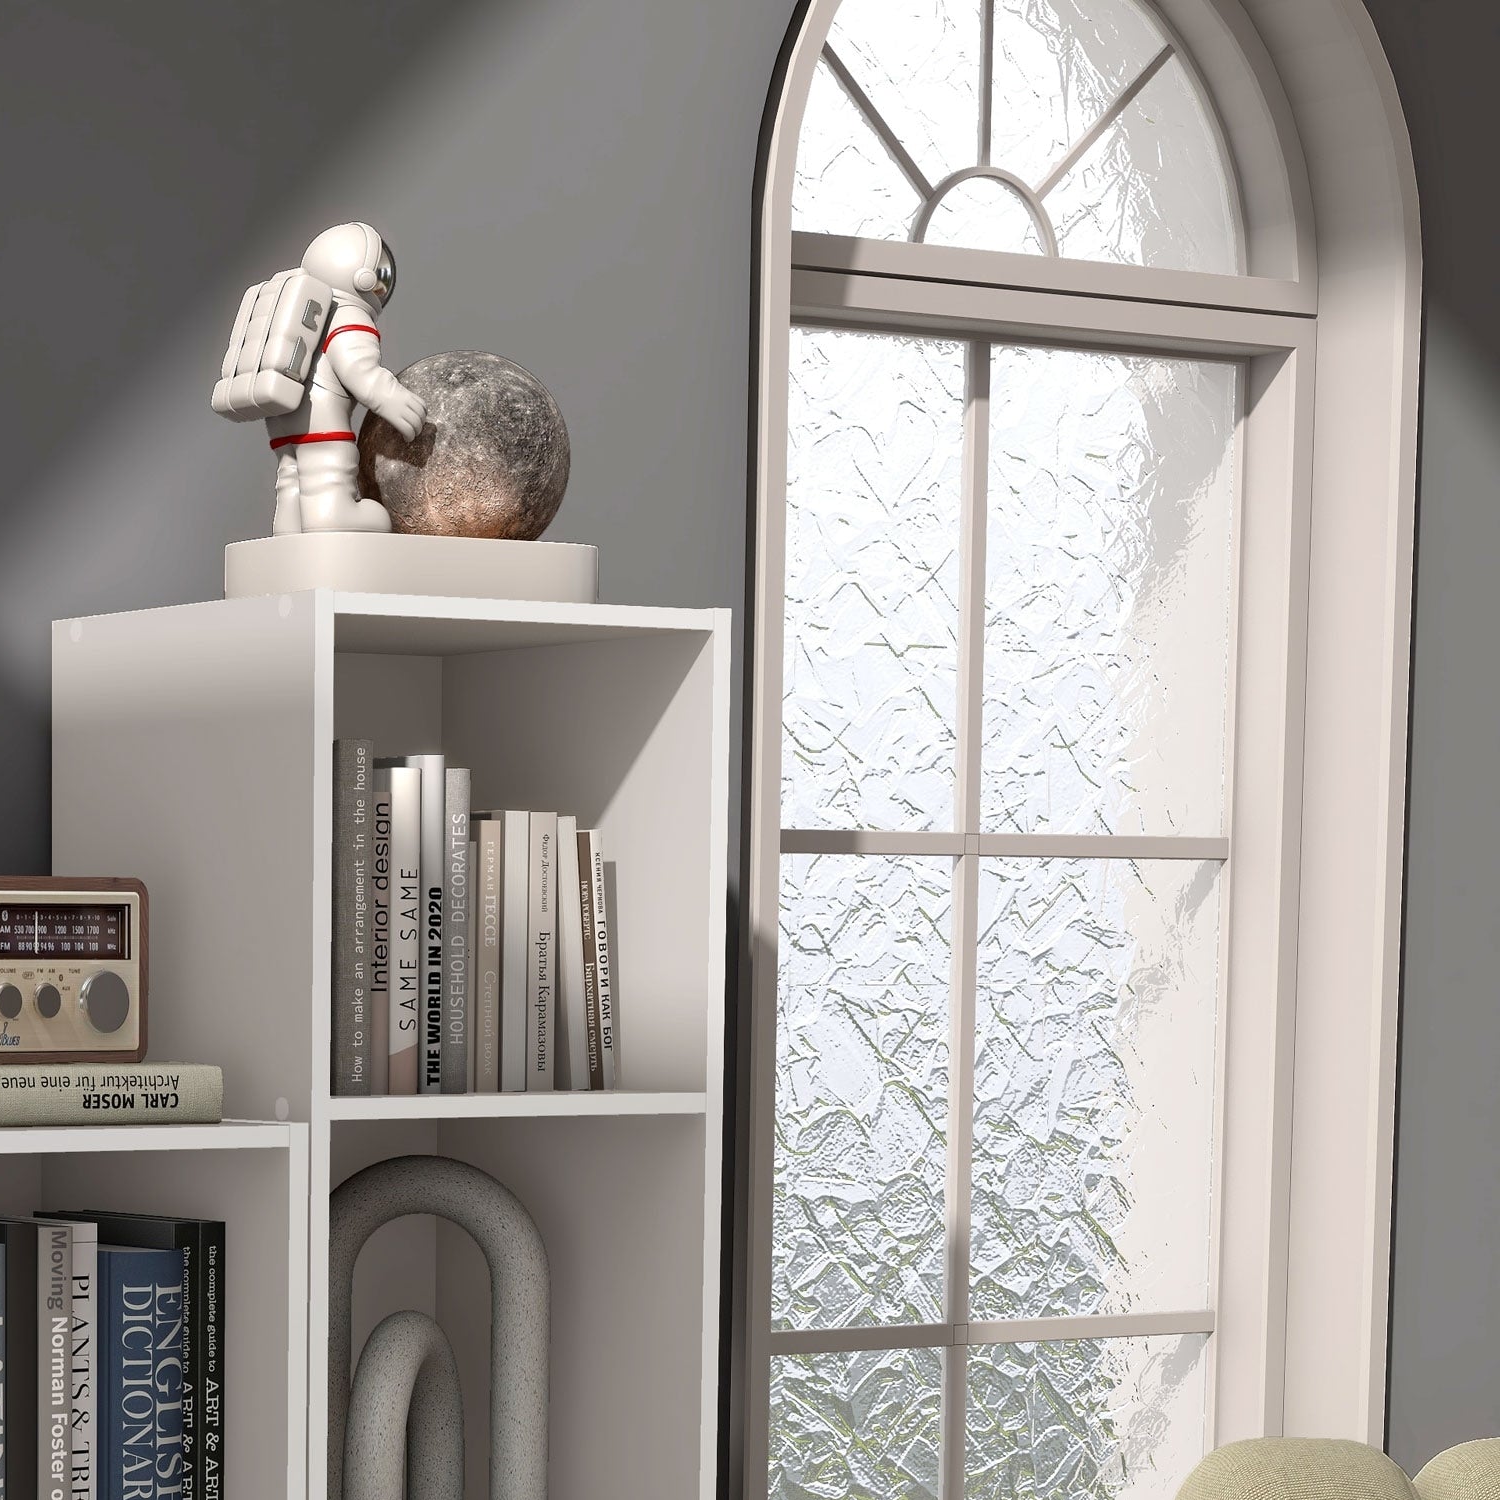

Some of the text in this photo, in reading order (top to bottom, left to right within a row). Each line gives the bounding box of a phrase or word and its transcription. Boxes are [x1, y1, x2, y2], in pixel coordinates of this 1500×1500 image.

[352, 747, 367, 1082] How to make an arrangement in the house
[371, 802, 391, 991] Interior design
[0, 925, 11, 934] AM
[14, 925, 24, 935] 530
[25, 925, 34, 935] 700
[54, 925, 67, 935] 1200
[72, 925, 84, 935] 1500
[87, 925, 100, 935] 1700
[450, 813, 466, 1044] HOUSEHOLD DECORATES
[484, 895, 497, 947] ГЕССЕ
[0, 942, 11, 951] FM
[18, 942, 25, 951] 88
[25, 942, 33, 951] 90
[40, 942, 47, 951] 94
[47, 942, 55, 951] 96
[61, 942, 71, 951] 100
[74, 942, 84, 951] 104
[89, 942, 99, 951] 108
[399, 869, 418, 1030] SAME SAME
[427, 887, 443, 1086] THE WORLD IN 2020
[535, 932, 550, 1072] Братья Карамазовы
[597, 920, 613, 1051] ГОВОРИ КАК БОГ
[585, 962, 598, 1072] Бархатная смерть
[1, 1076, 36, 1089] neue
[41, 1076, 70, 1092] eine
[75, 1075, 95, 1092] für
[82, 1093, 179, 1109] CARL MOSER
[100, 1075, 179, 1091] Architektur
[47, 1231, 67, 1310] Moving
[182, 1246, 191, 1267] the
[208, 1245, 216, 1266] the
[182, 1269, 191, 1324] complete
[207, 1267, 216, 1323] complete
[72, 1274, 91, 1400] PLANTS
[182, 1326, 191, 1359] guide
[207, 1324, 217, 1359] guide
[51, 1317, 68, 1406] Norman
[182, 1361, 190, 1374] to
[208, 1359, 216, 1373] to
[72, 1408, 91, 1432] &
[182, 1382, 195, 1429] ART
[206, 1377, 220, 1427] ART
[51, 1413, 68, 1483] Foster
[182, 1434, 194, 1454] &
[205, 1432, 220, 1452] &
